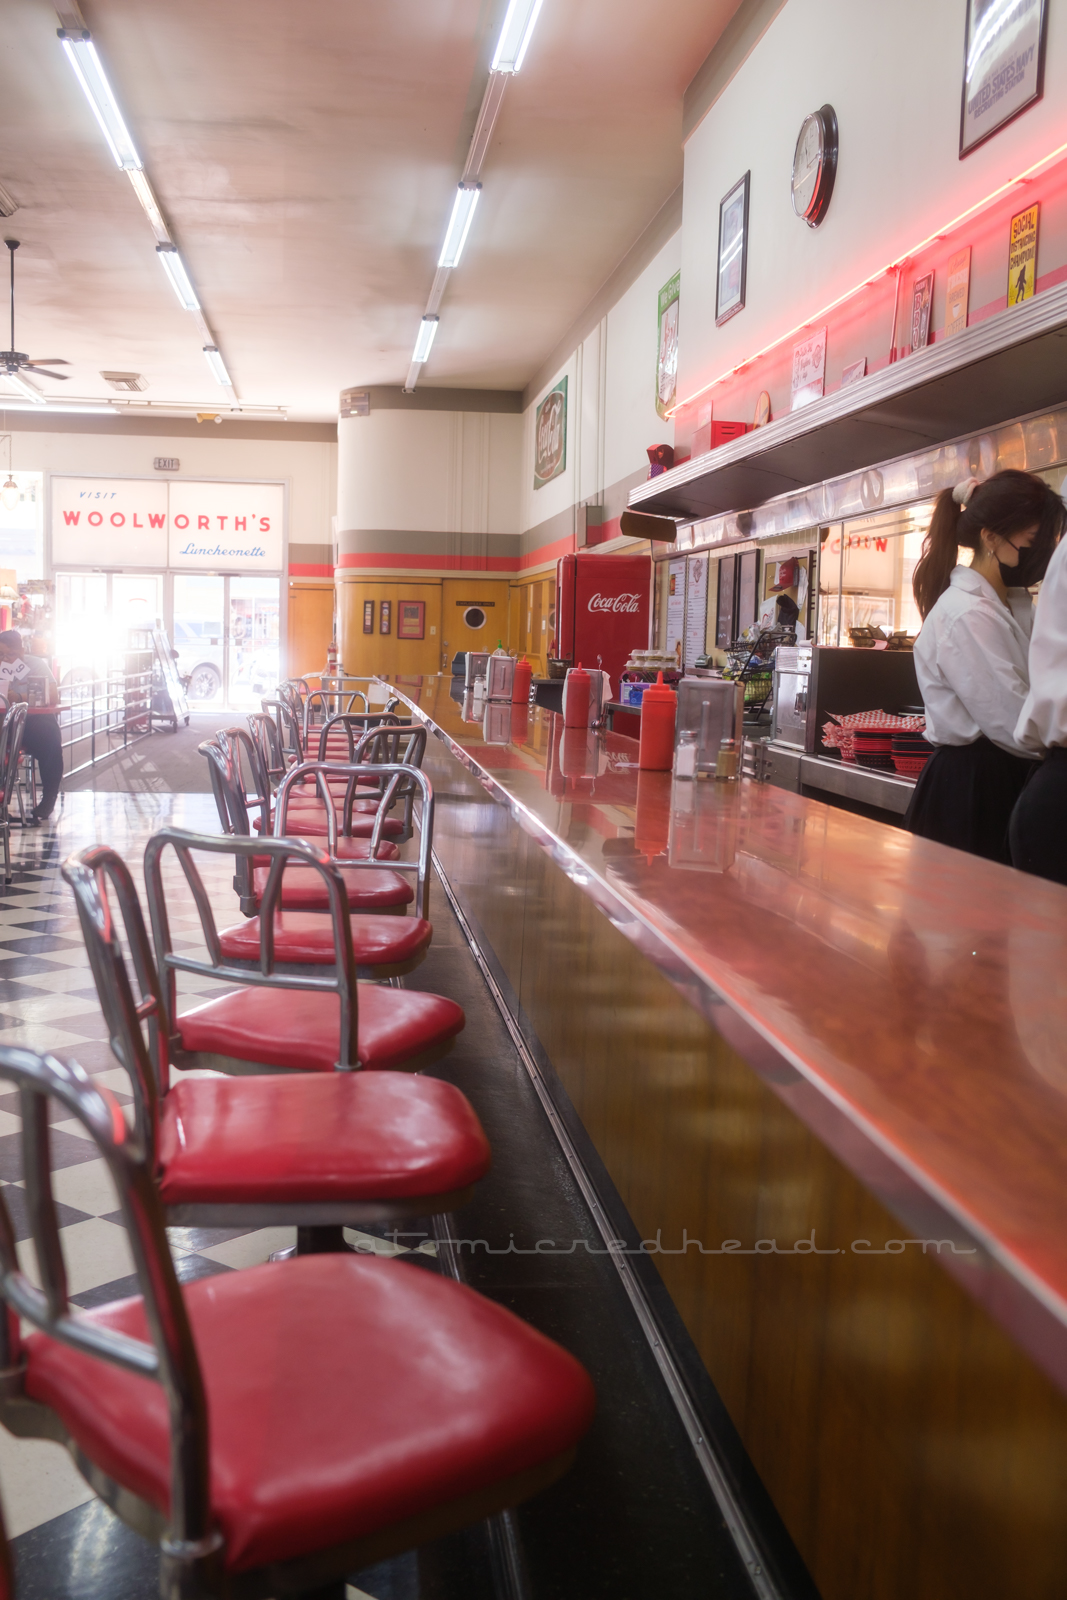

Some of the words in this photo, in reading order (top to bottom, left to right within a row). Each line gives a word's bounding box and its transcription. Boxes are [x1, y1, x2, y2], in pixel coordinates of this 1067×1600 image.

[968, 82, 991, 115] UNITED
[992, 60, 1016, 94] STATES
[1016, 43, 1035, 74] NAVY
[974, 87, 1004, 119] RECRUITING
[1005, 69, 1025, 94] STATION
[1013, 211, 1035, 239] SOCIAL
[1010, 230, 1036, 253] DISTANCING
[158, 459, 175, 469] EXIT
[63, 511, 271, 532] WOOLWORTH'S
[179, 543, 266, 557] Luncheonette
